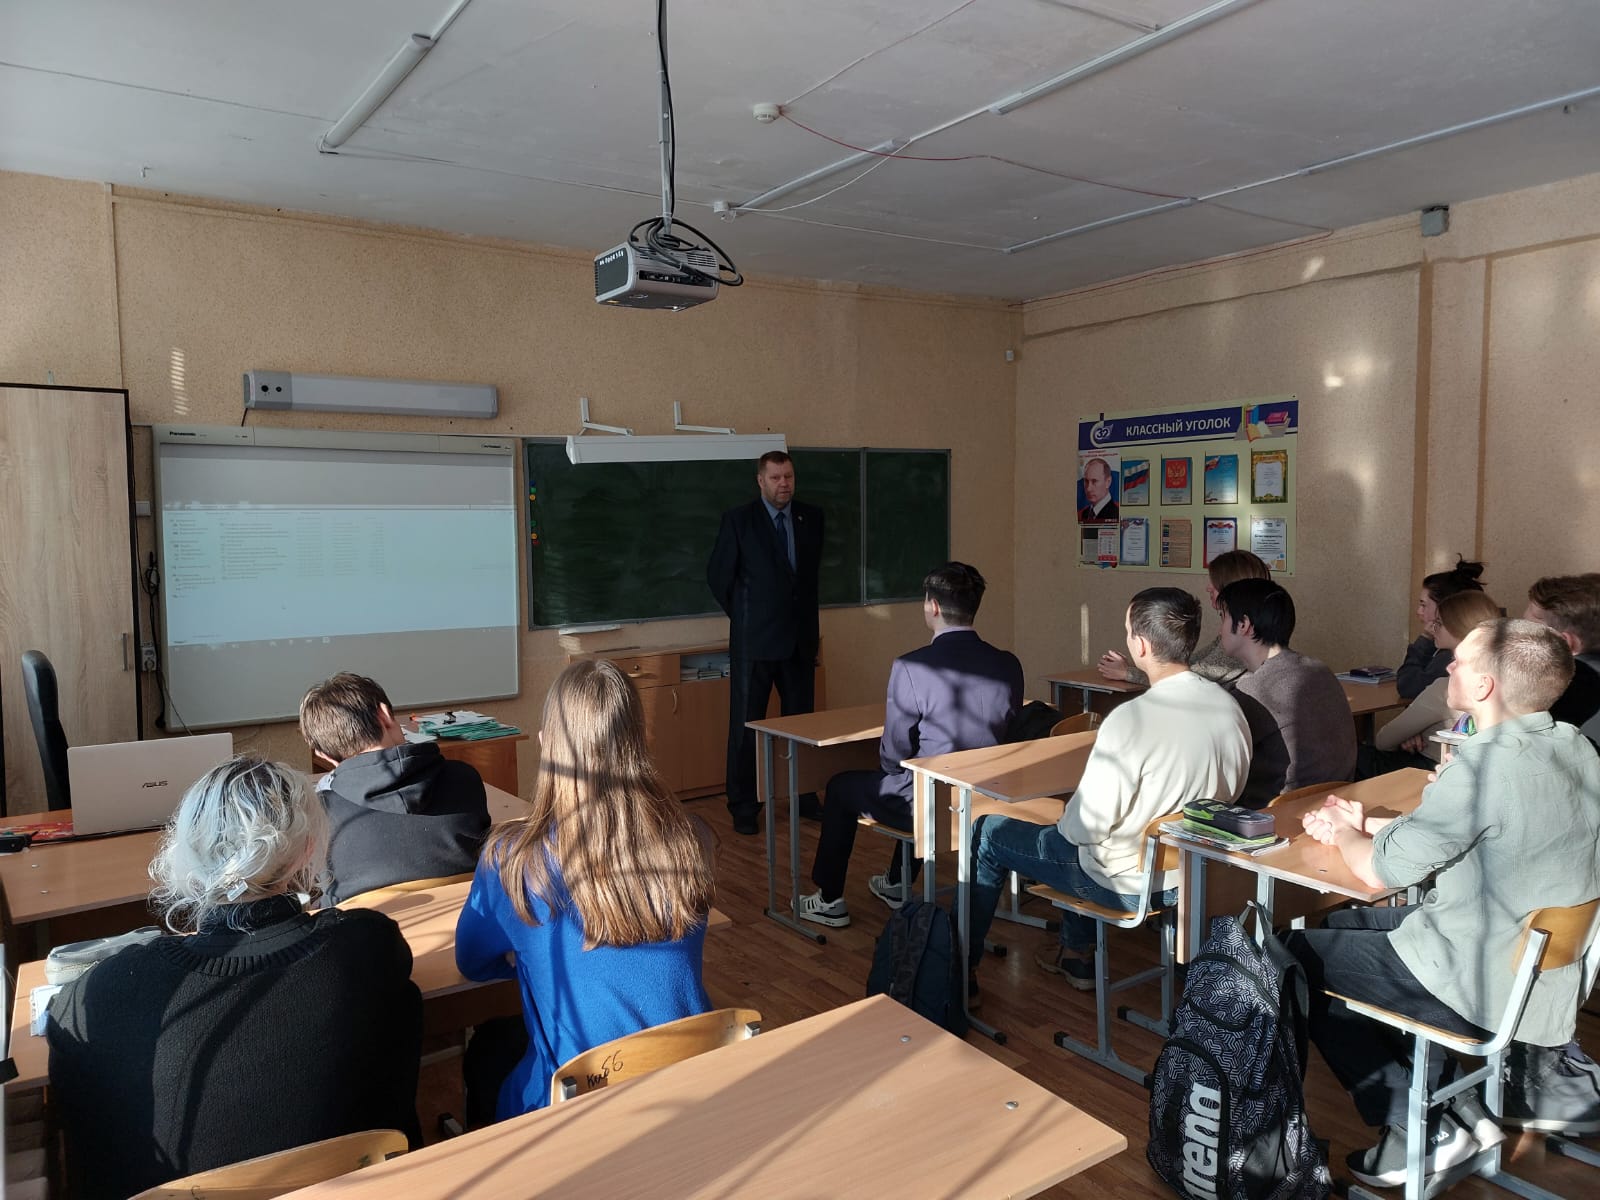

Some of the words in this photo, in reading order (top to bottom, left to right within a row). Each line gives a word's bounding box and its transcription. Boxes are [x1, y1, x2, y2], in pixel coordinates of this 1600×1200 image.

[1126, 419, 1183, 437] КЛАССНЫЙ
[1186, 417, 1231, 431] УГОЛОК
[142, 780, 168, 788] ASUS
[1430, 1130, 1450, 1145] FILA
